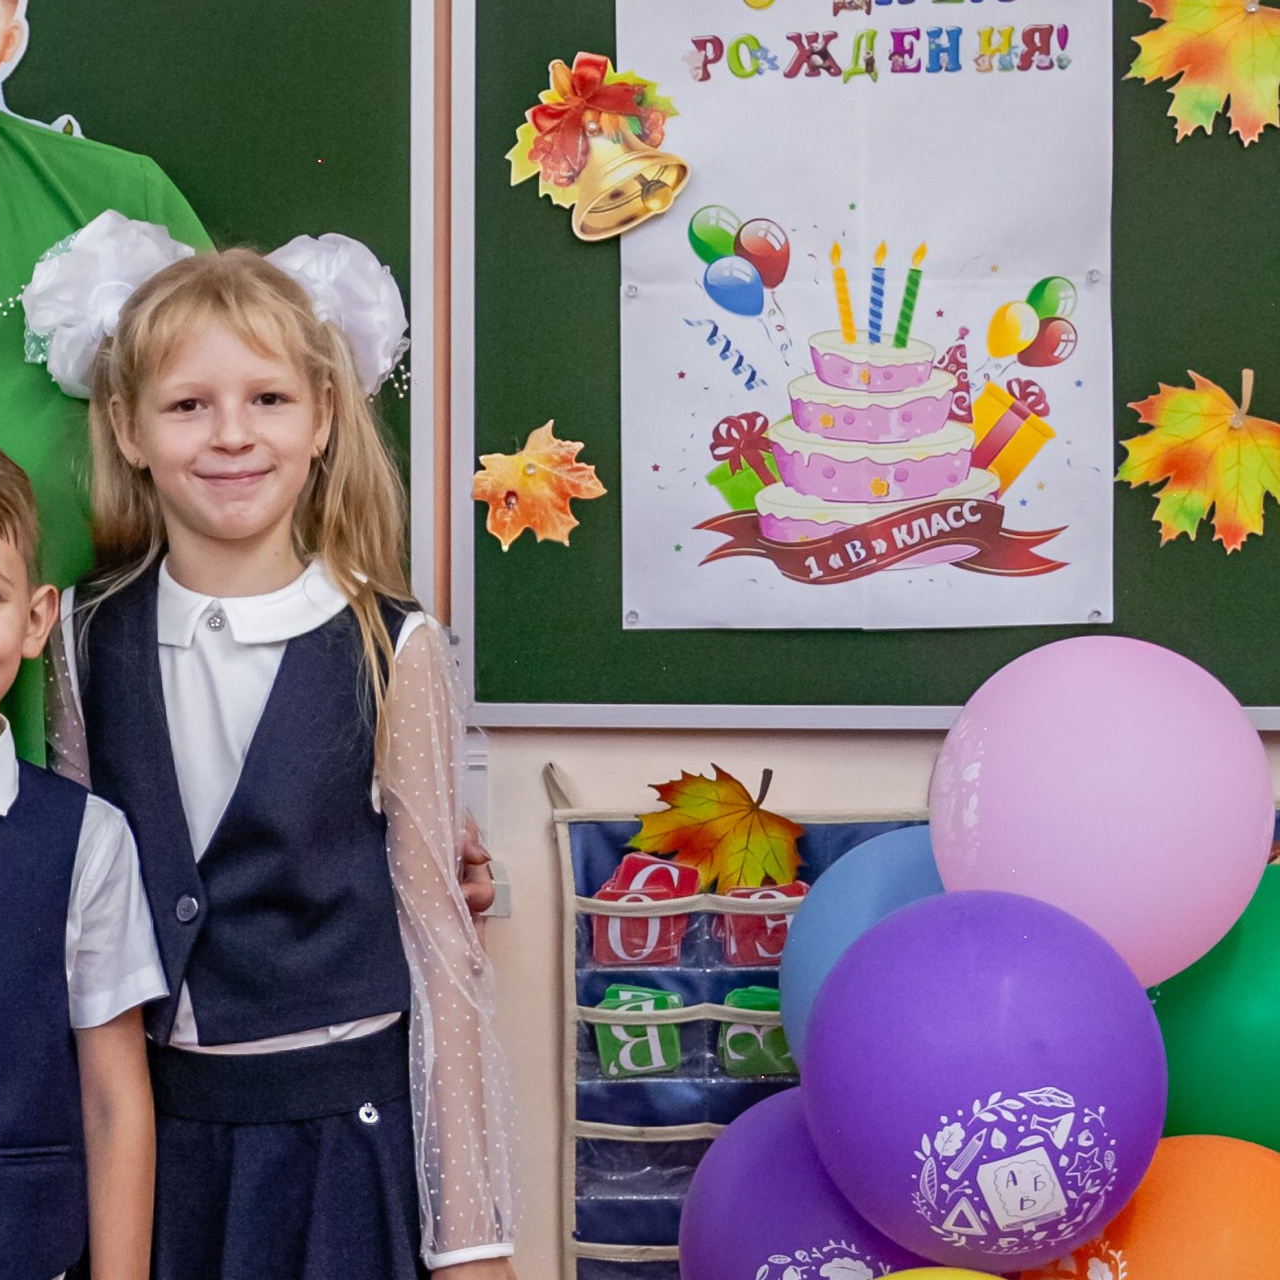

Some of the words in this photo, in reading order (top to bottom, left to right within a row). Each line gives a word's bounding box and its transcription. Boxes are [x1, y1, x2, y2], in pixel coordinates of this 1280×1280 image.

[683, 23, 1072, 84] РОЖДЕНИЯ!
[804, 555, 824, 579] 1
[891, 500, 982, 549] КЛАСС
